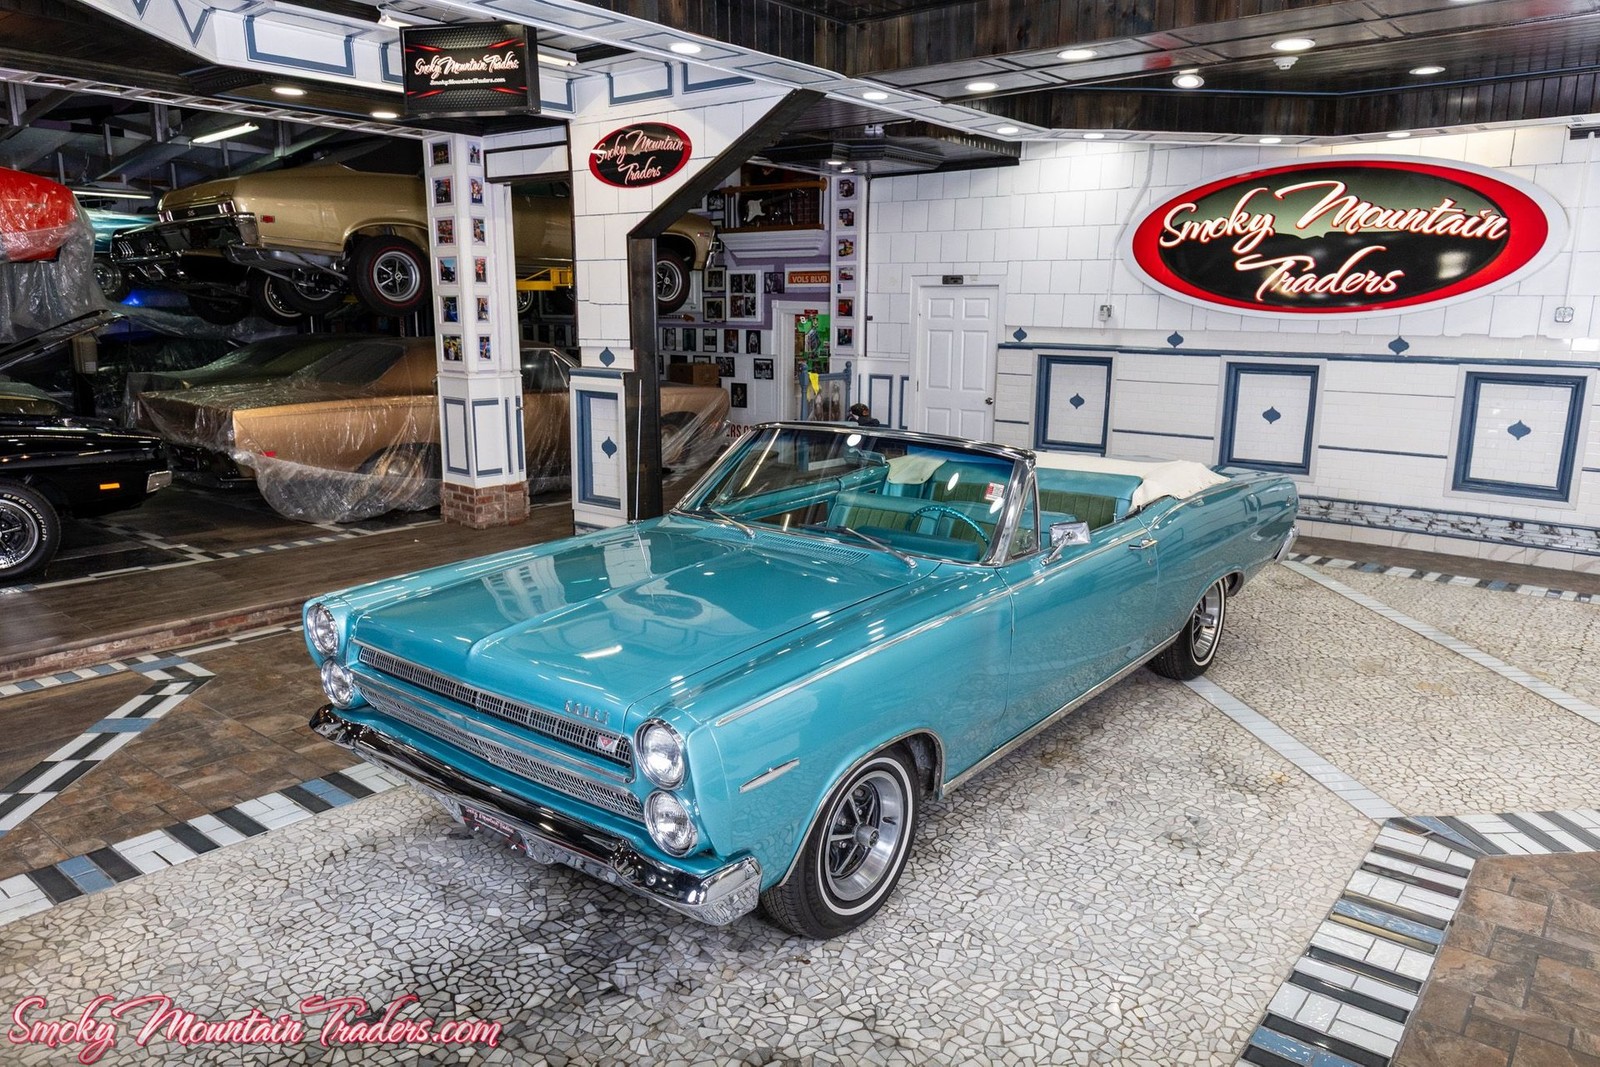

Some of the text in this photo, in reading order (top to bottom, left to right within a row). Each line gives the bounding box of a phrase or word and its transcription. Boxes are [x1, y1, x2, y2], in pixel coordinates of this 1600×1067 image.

[414, 50, 520, 79] Smoky Mountain Traders
[596, 129, 684, 165] Smoky Mountain
[618, 156, 662, 185] Traders
[1159, 179, 1512, 254] Smoky Mountain
[791, 275, 828, 283] VOLS BLVD
[1234, 245, 1405, 302] Traders
